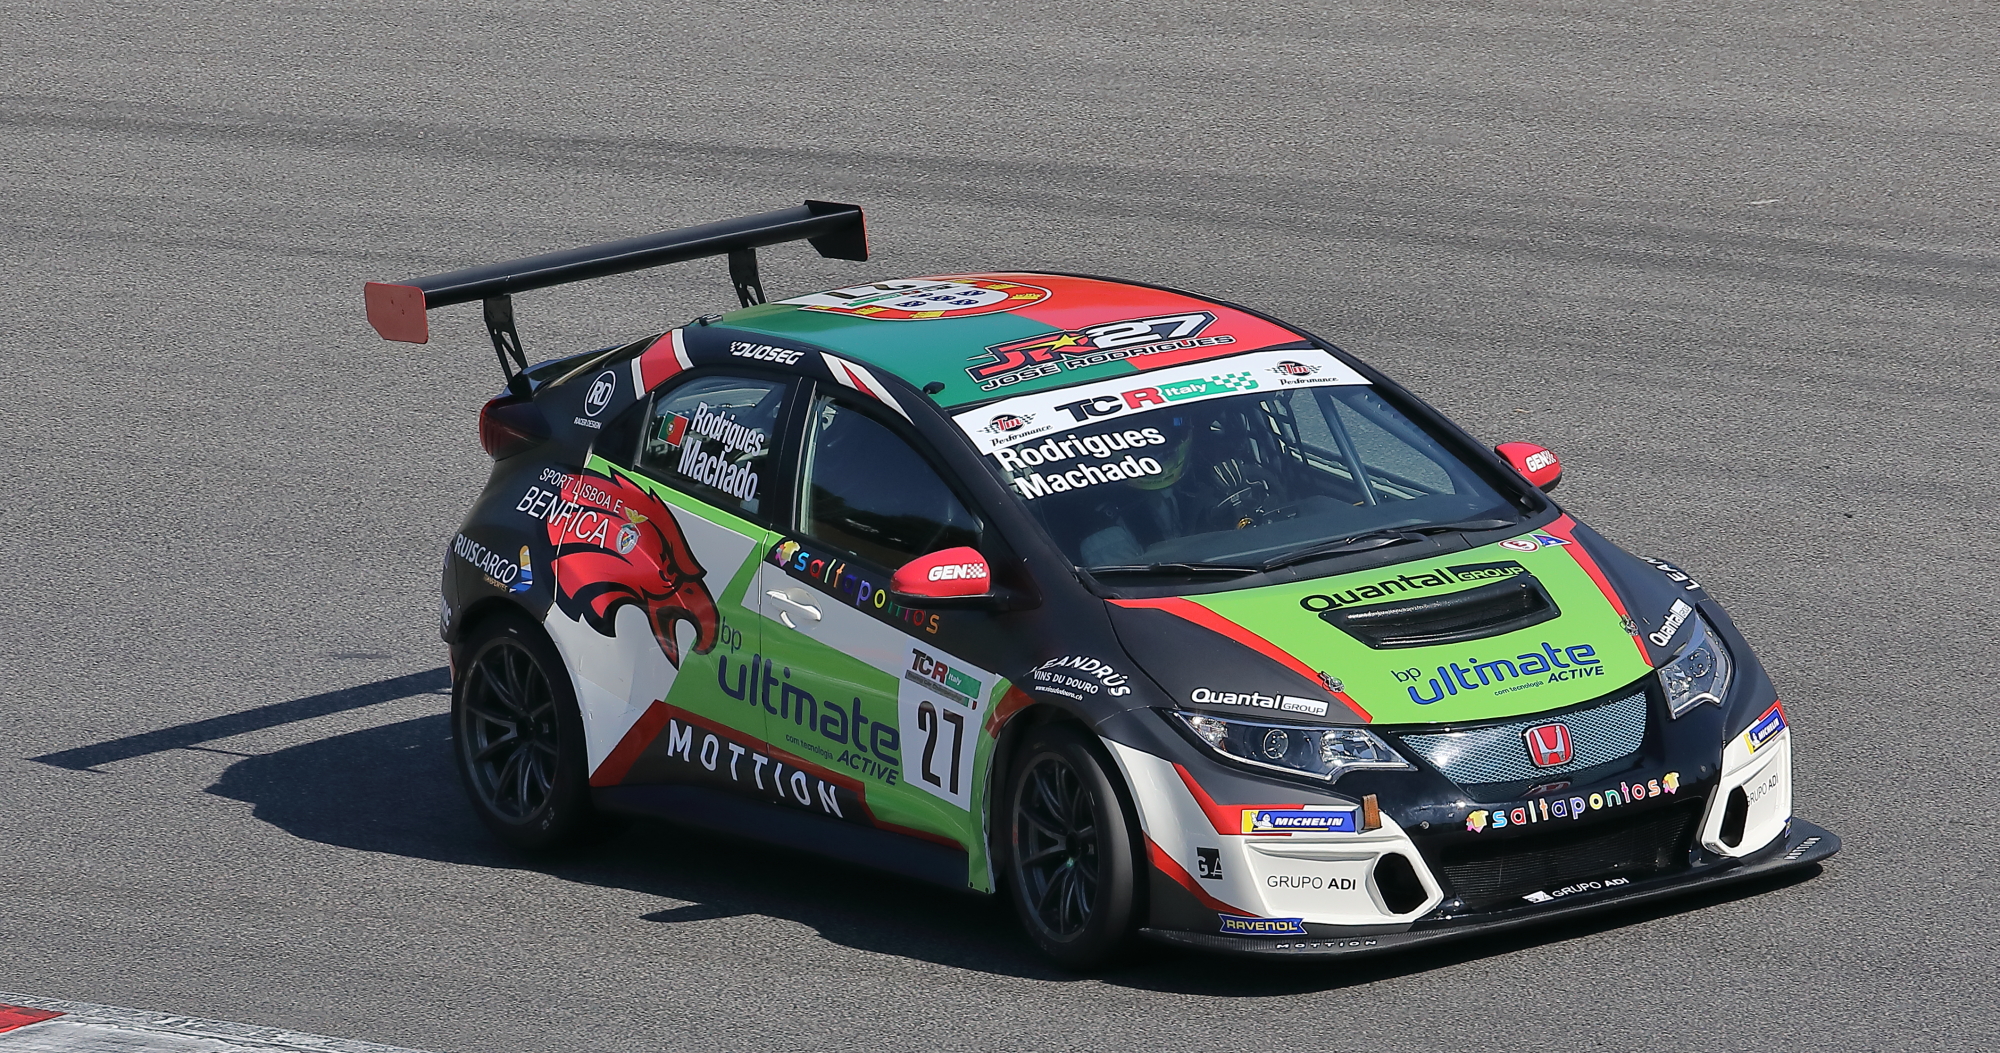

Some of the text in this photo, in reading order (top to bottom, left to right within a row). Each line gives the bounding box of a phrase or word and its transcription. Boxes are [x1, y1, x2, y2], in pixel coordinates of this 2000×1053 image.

[1087, 313, 1209, 349] 27
[730, 342, 805, 366] DUOSEG
[1067, 336, 1236, 370] RODRIGUES
[588, 381, 612, 405] RD
[1278, 377, 1339, 385] Performance
[1055, 382, 1207, 423] TCR Italy
[691, 401, 764, 457] Rodrigues
[990, 425, 1053, 446] Performance
[992, 427, 1166, 472] Rodrigues
[677, 437, 758, 501] Machado
[1014, 455, 1163, 500] Machado
[539, 468, 623, 514] SPORT LISBOA E
[516, 486, 609, 549] BENFICA
[454, 534, 518, 584] RUISCARGO
[1300, 565, 1525, 612] Quantal GROUP
[721, 617, 742, 654] bp
[1649, 609, 1685, 647] Quantal
[912, 648, 962, 686] TCR Italy
[1034, 670, 1098, 694] VINS DU DOURO
[1391, 667, 1421, 683] bp
[1407, 642, 1600, 705] ultimate
[1548, 666, 1604, 683] ACTIVE
[1191, 688, 1324, 714] Quantal GROUP
[1494, 680, 1544, 696] com tecnologia
[718, 653, 900, 766] ultimate
[786, 734, 833, 760] com tecnologia
[1758, 717, 1780, 741] MICHELIN
[917, 700, 964, 795] 27
[667, 718, 844, 819] MOTTION
[837, 750, 900, 786] ACTIVE
[1768, 772, 1779, 788] ADI
[1275, 817, 1343, 826] MICHELIN
[1492, 779, 1661, 829] saltapontos
[1267, 875, 1356, 890] GRUPO ADI
[1552, 881, 1601, 897] GRUPO
[1604, 877, 1630, 887] ADI
[1226, 918, 1298, 931] RAVENOL
[1276, 940, 1378, 948] MOTTION
